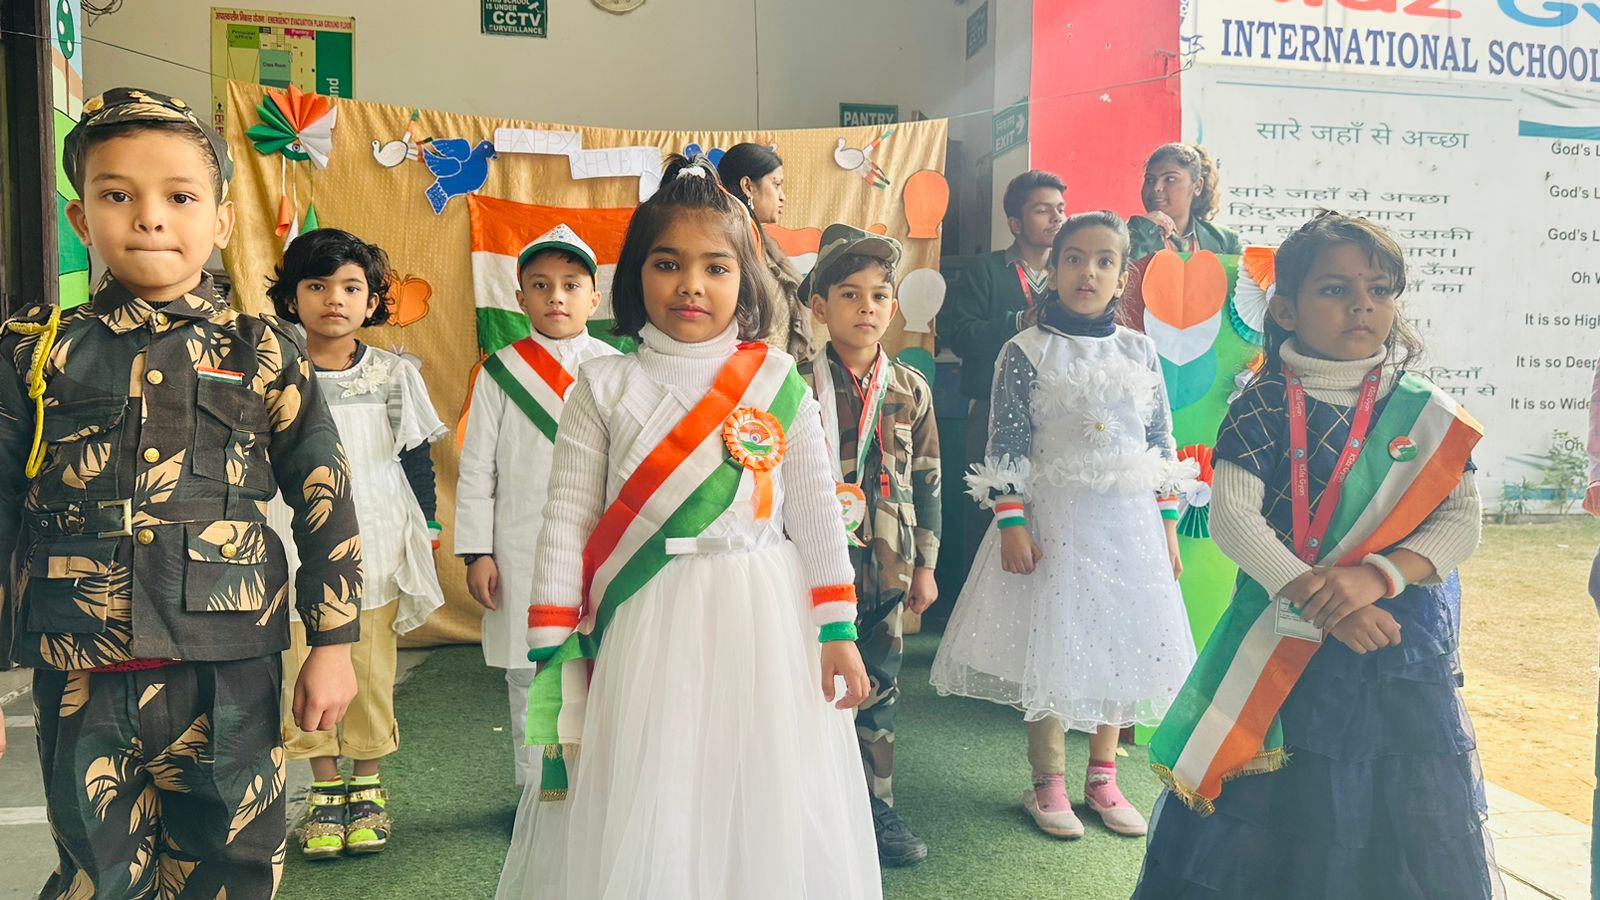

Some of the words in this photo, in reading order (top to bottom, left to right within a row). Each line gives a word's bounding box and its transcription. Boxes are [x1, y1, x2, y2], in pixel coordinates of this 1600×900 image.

[492, 11, 542, 27] CCTV
[1221, 18, 1478, 73] INTERNATIONAL
[1488, 39, 1600, 83] SCHOOL
[843, 111, 895, 126] PANTRY
[498, 129, 577, 153] HAPPY
[995, 130, 1016, 152] EXIT
[1256, 118, 1302, 141] सारे
[1310, 121, 1365, 146] जहाँ
[1370, 122, 1393, 145] से
[1402, 129, 1470, 149] अच्छा
[1551, 141, 1591, 156] God's
[1228, 184, 1277, 198] सारे
[1285, 186, 1341, 201] जहाँ
[1346, 188, 1371, 202] से
[1380, 193, 1451, 205] अच्छा
[1549, 184, 1589, 199] God's
[1547, 228, 1588, 242] God's
[1571, 271, 1591, 285] Oh
[1525, 313, 1534, 326] It
[1538, 313, 1549, 326] is
[1553, 316, 1570, 326] so
[1516, 355, 1525, 368] It
[1529, 356, 1541, 368] is
[1545, 358, 1561, 368] so
[1510, 398, 1519, 410] It
[1523, 398, 1535, 410] is
[1539, 400, 1556, 410] so
[1564, 439, 1584, 451] Oh
